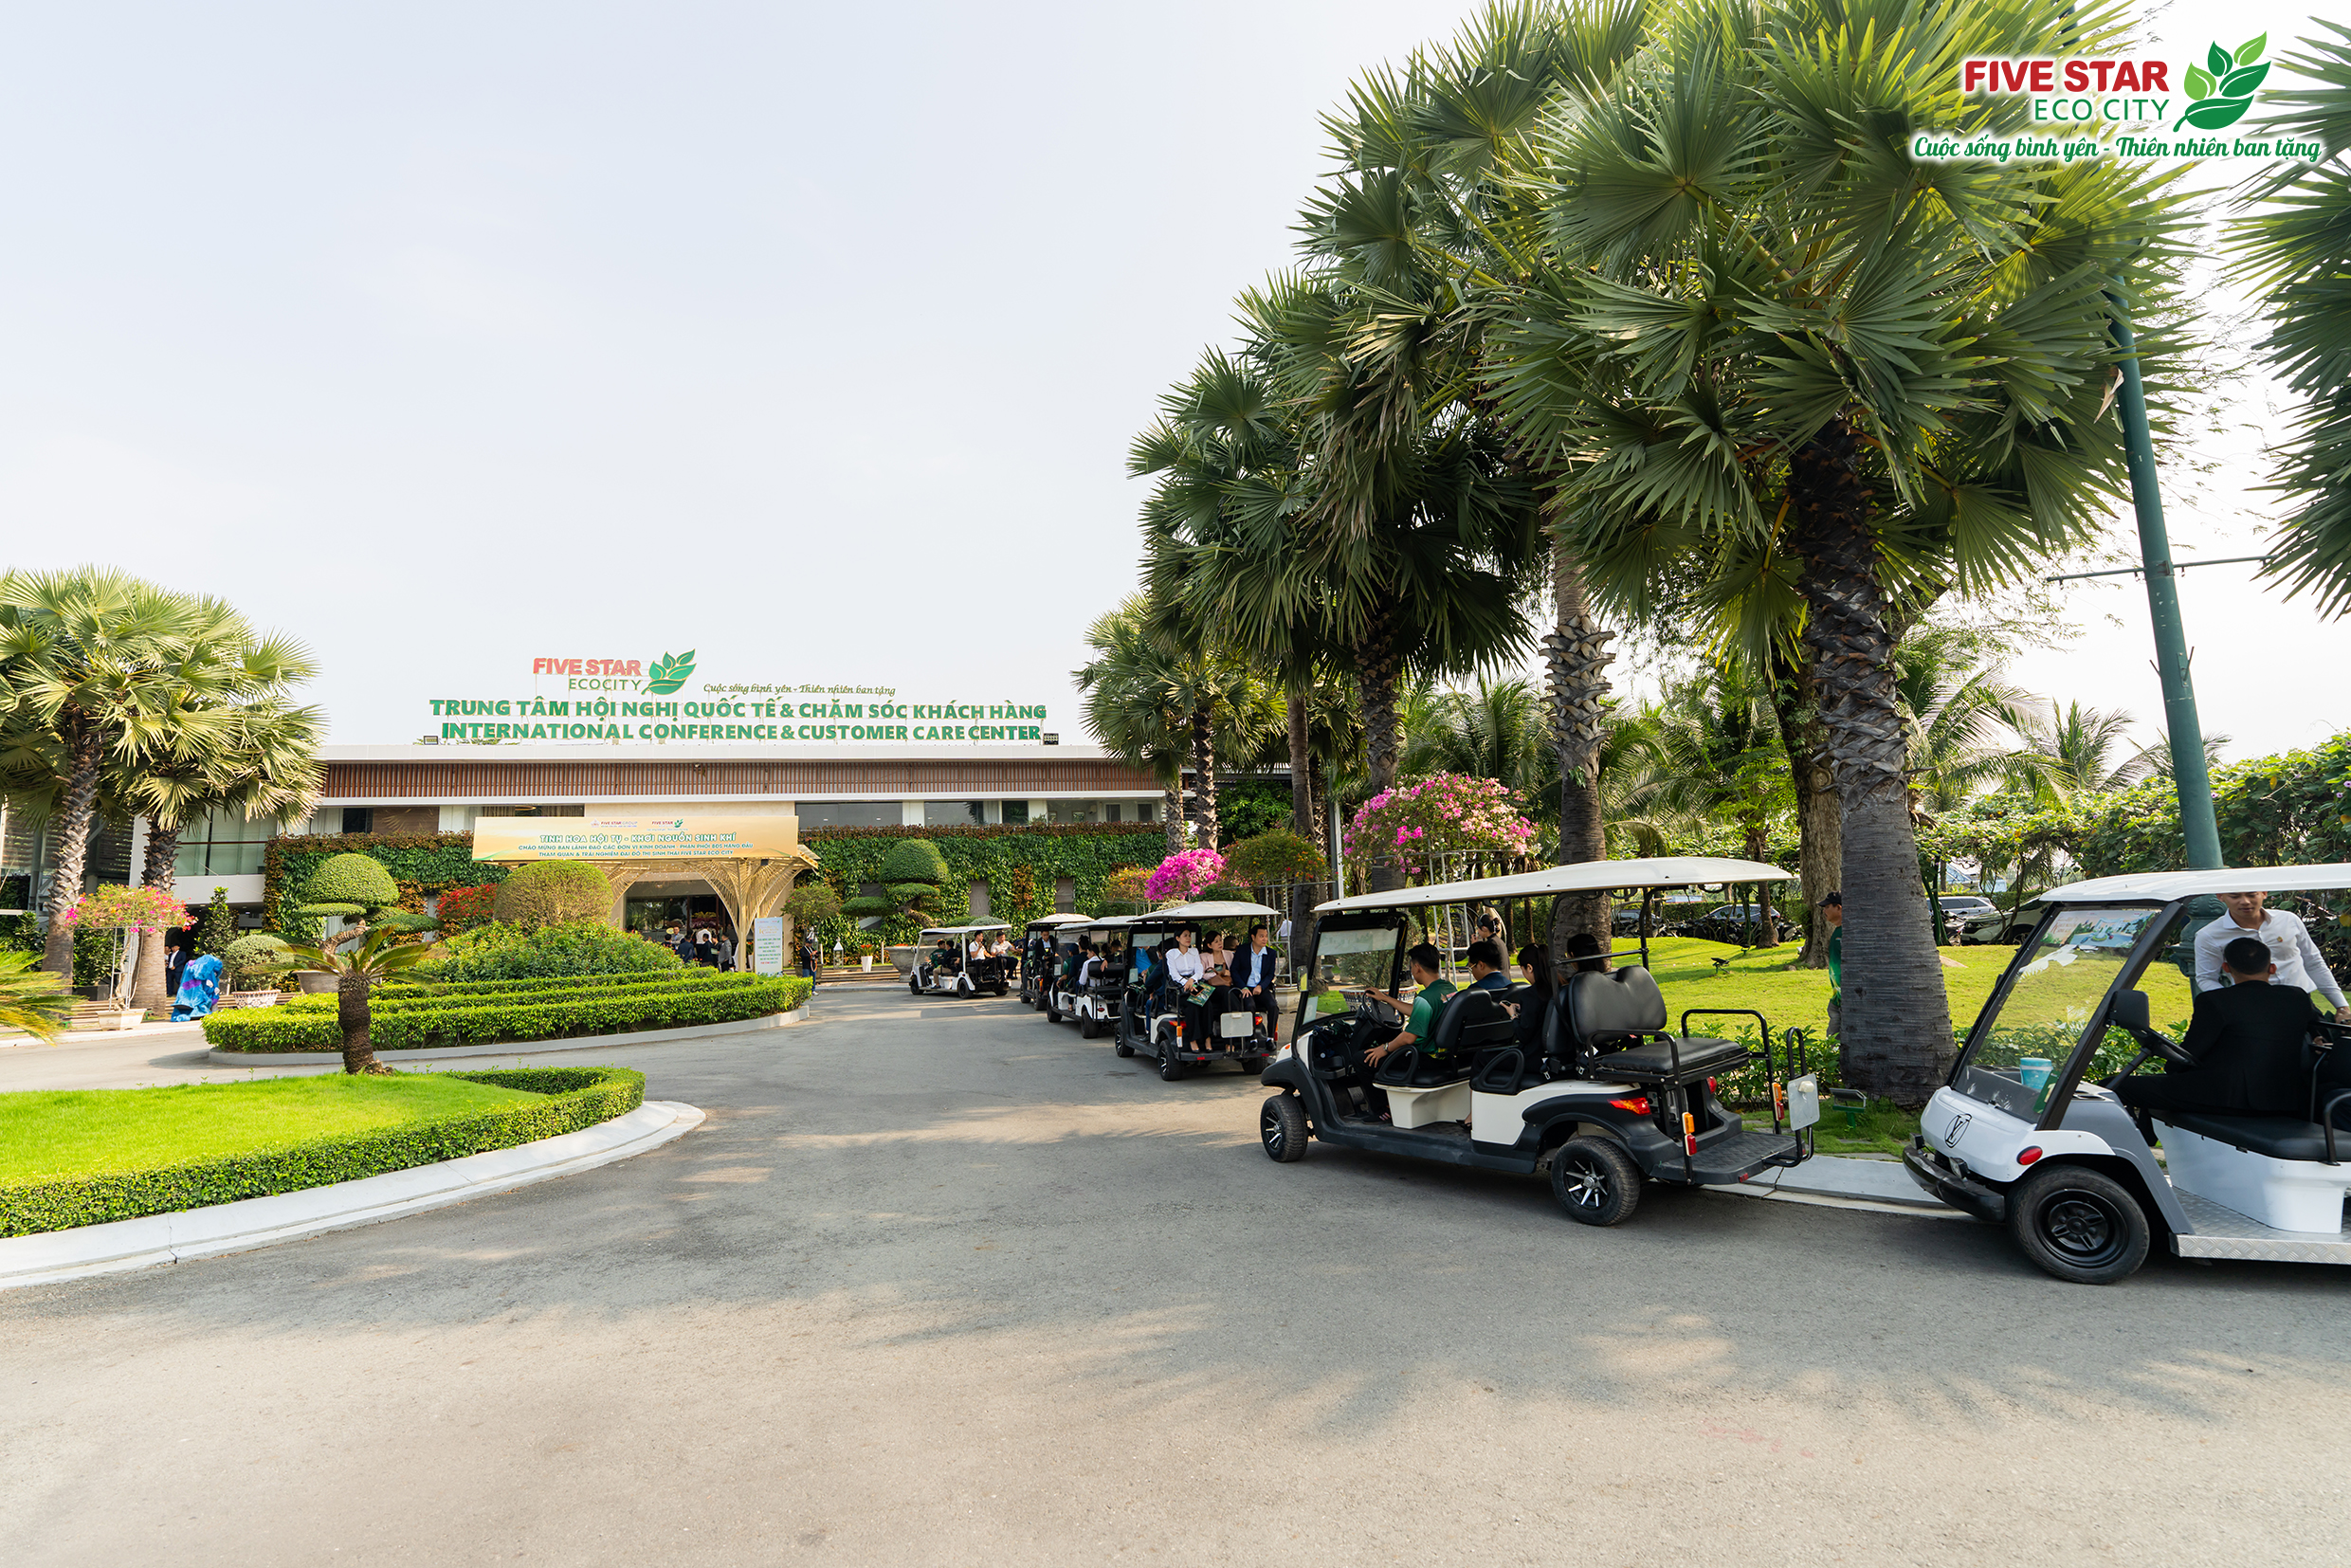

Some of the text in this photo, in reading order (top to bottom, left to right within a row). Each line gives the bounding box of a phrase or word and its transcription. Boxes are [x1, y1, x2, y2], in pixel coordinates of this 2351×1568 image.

[533, 658, 642, 676] FIVE STAR
[703, 684, 727, 694] Cuộc
[729, 683, 750, 695] sống
[775, 684, 792, 695] yên
[799, 684, 826, 693] Thiên
[828, 684, 854, 694] nhiên
[855, 684, 873, 694] ban
[875, 685, 896, 697] tặng
[429, 694, 1047, 722] TRUNG TÂM HỘI NGHỊ QUỐC TẾ & CHĂM SÓC KHÁCH HÀNG
[442, 722, 1041, 740] INTERNATIONAL CONFERENCE & CUSTOMER CARE CENTER
[590, 833, 608, 844] HỘI
[611, 834, 622, 844] TỤ
[720, 831, 737, 842] KHÍ
